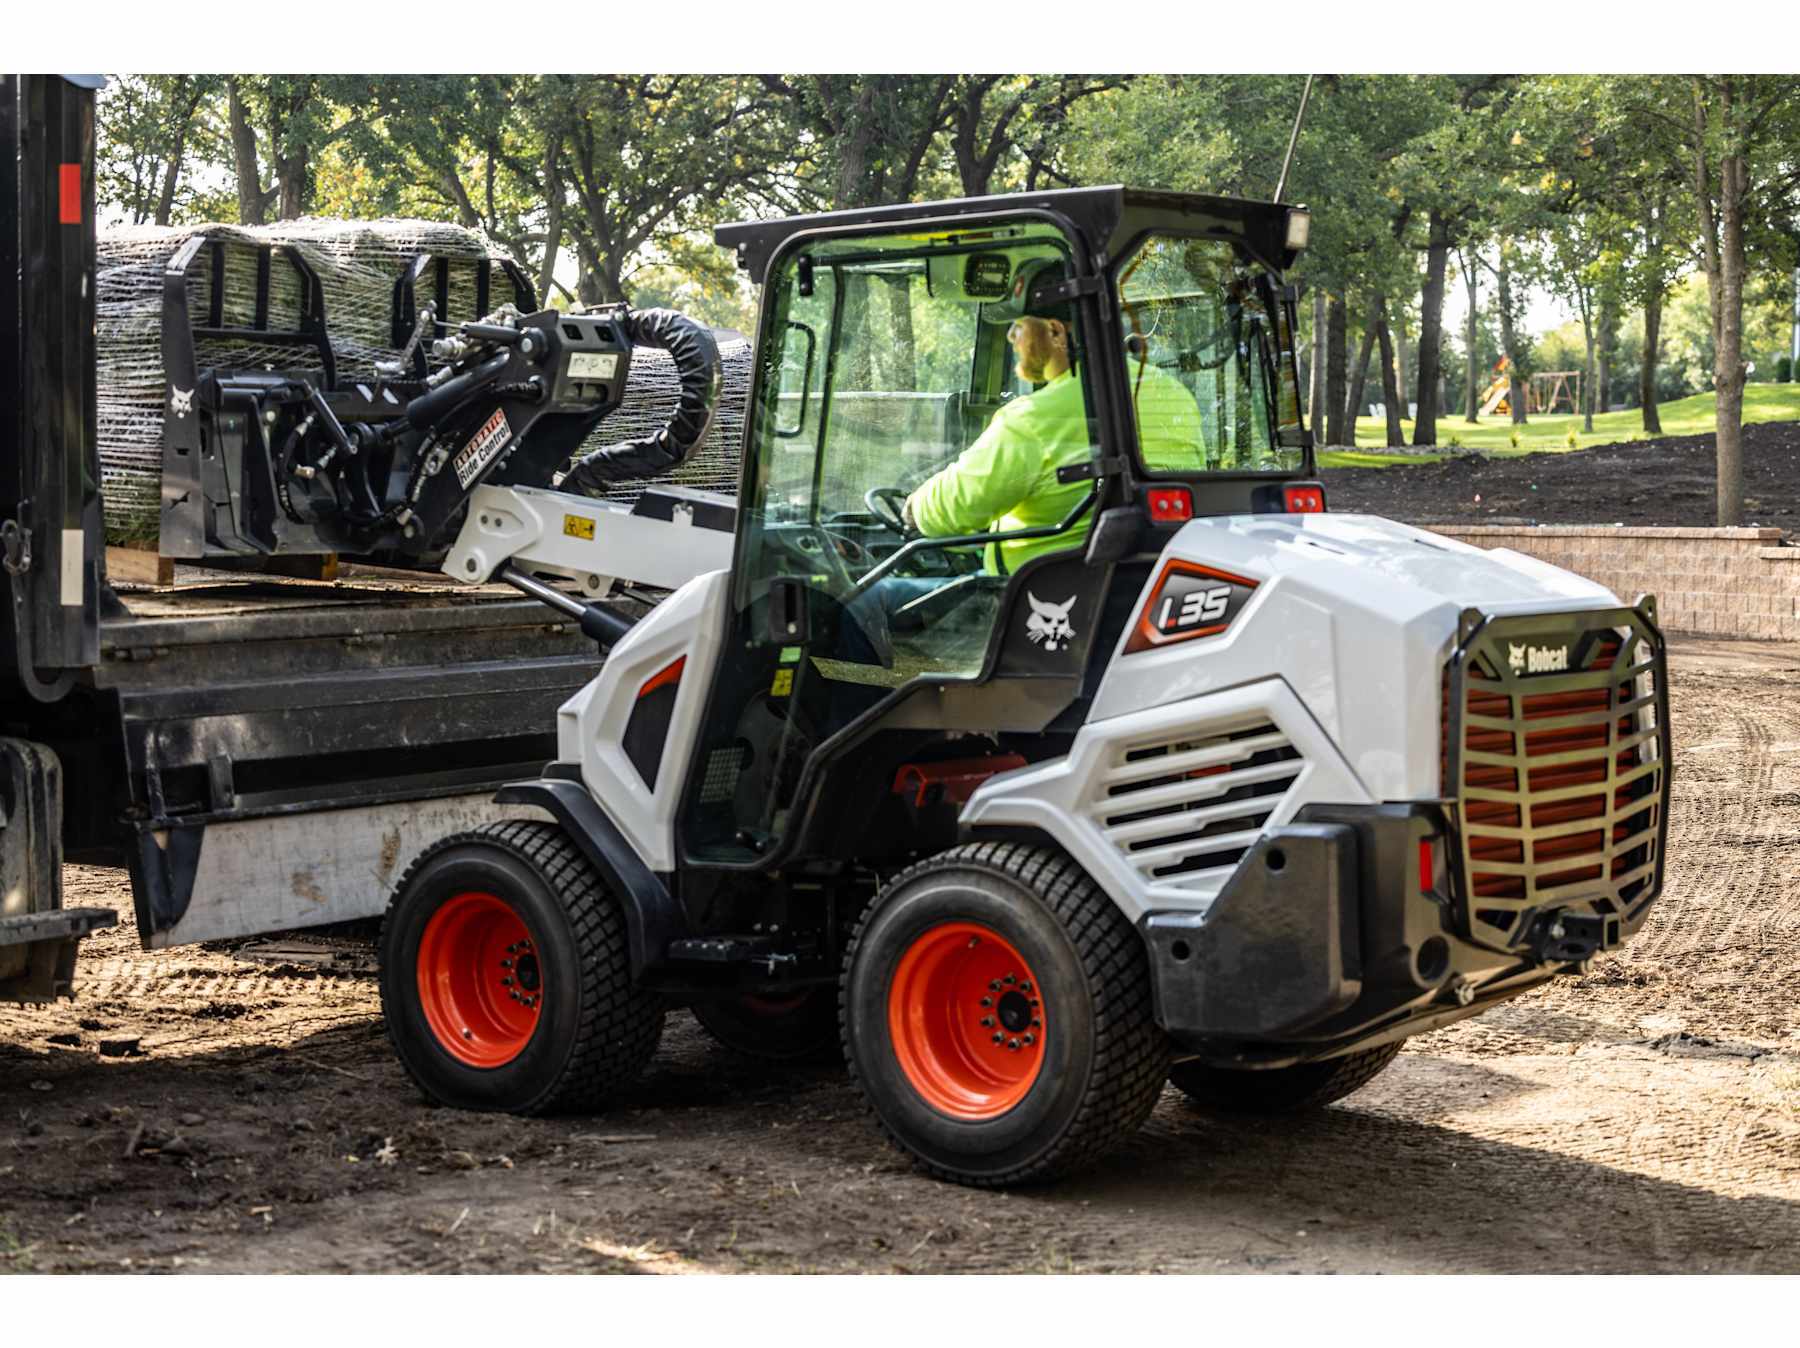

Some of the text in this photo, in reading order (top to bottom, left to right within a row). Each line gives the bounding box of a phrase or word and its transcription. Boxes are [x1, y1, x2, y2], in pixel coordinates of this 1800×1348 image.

[455, 409, 504, 471] AUTOMATIC
[459, 421, 510, 484] Ride Control
[1527, 645, 1568, 673] Bobcat
